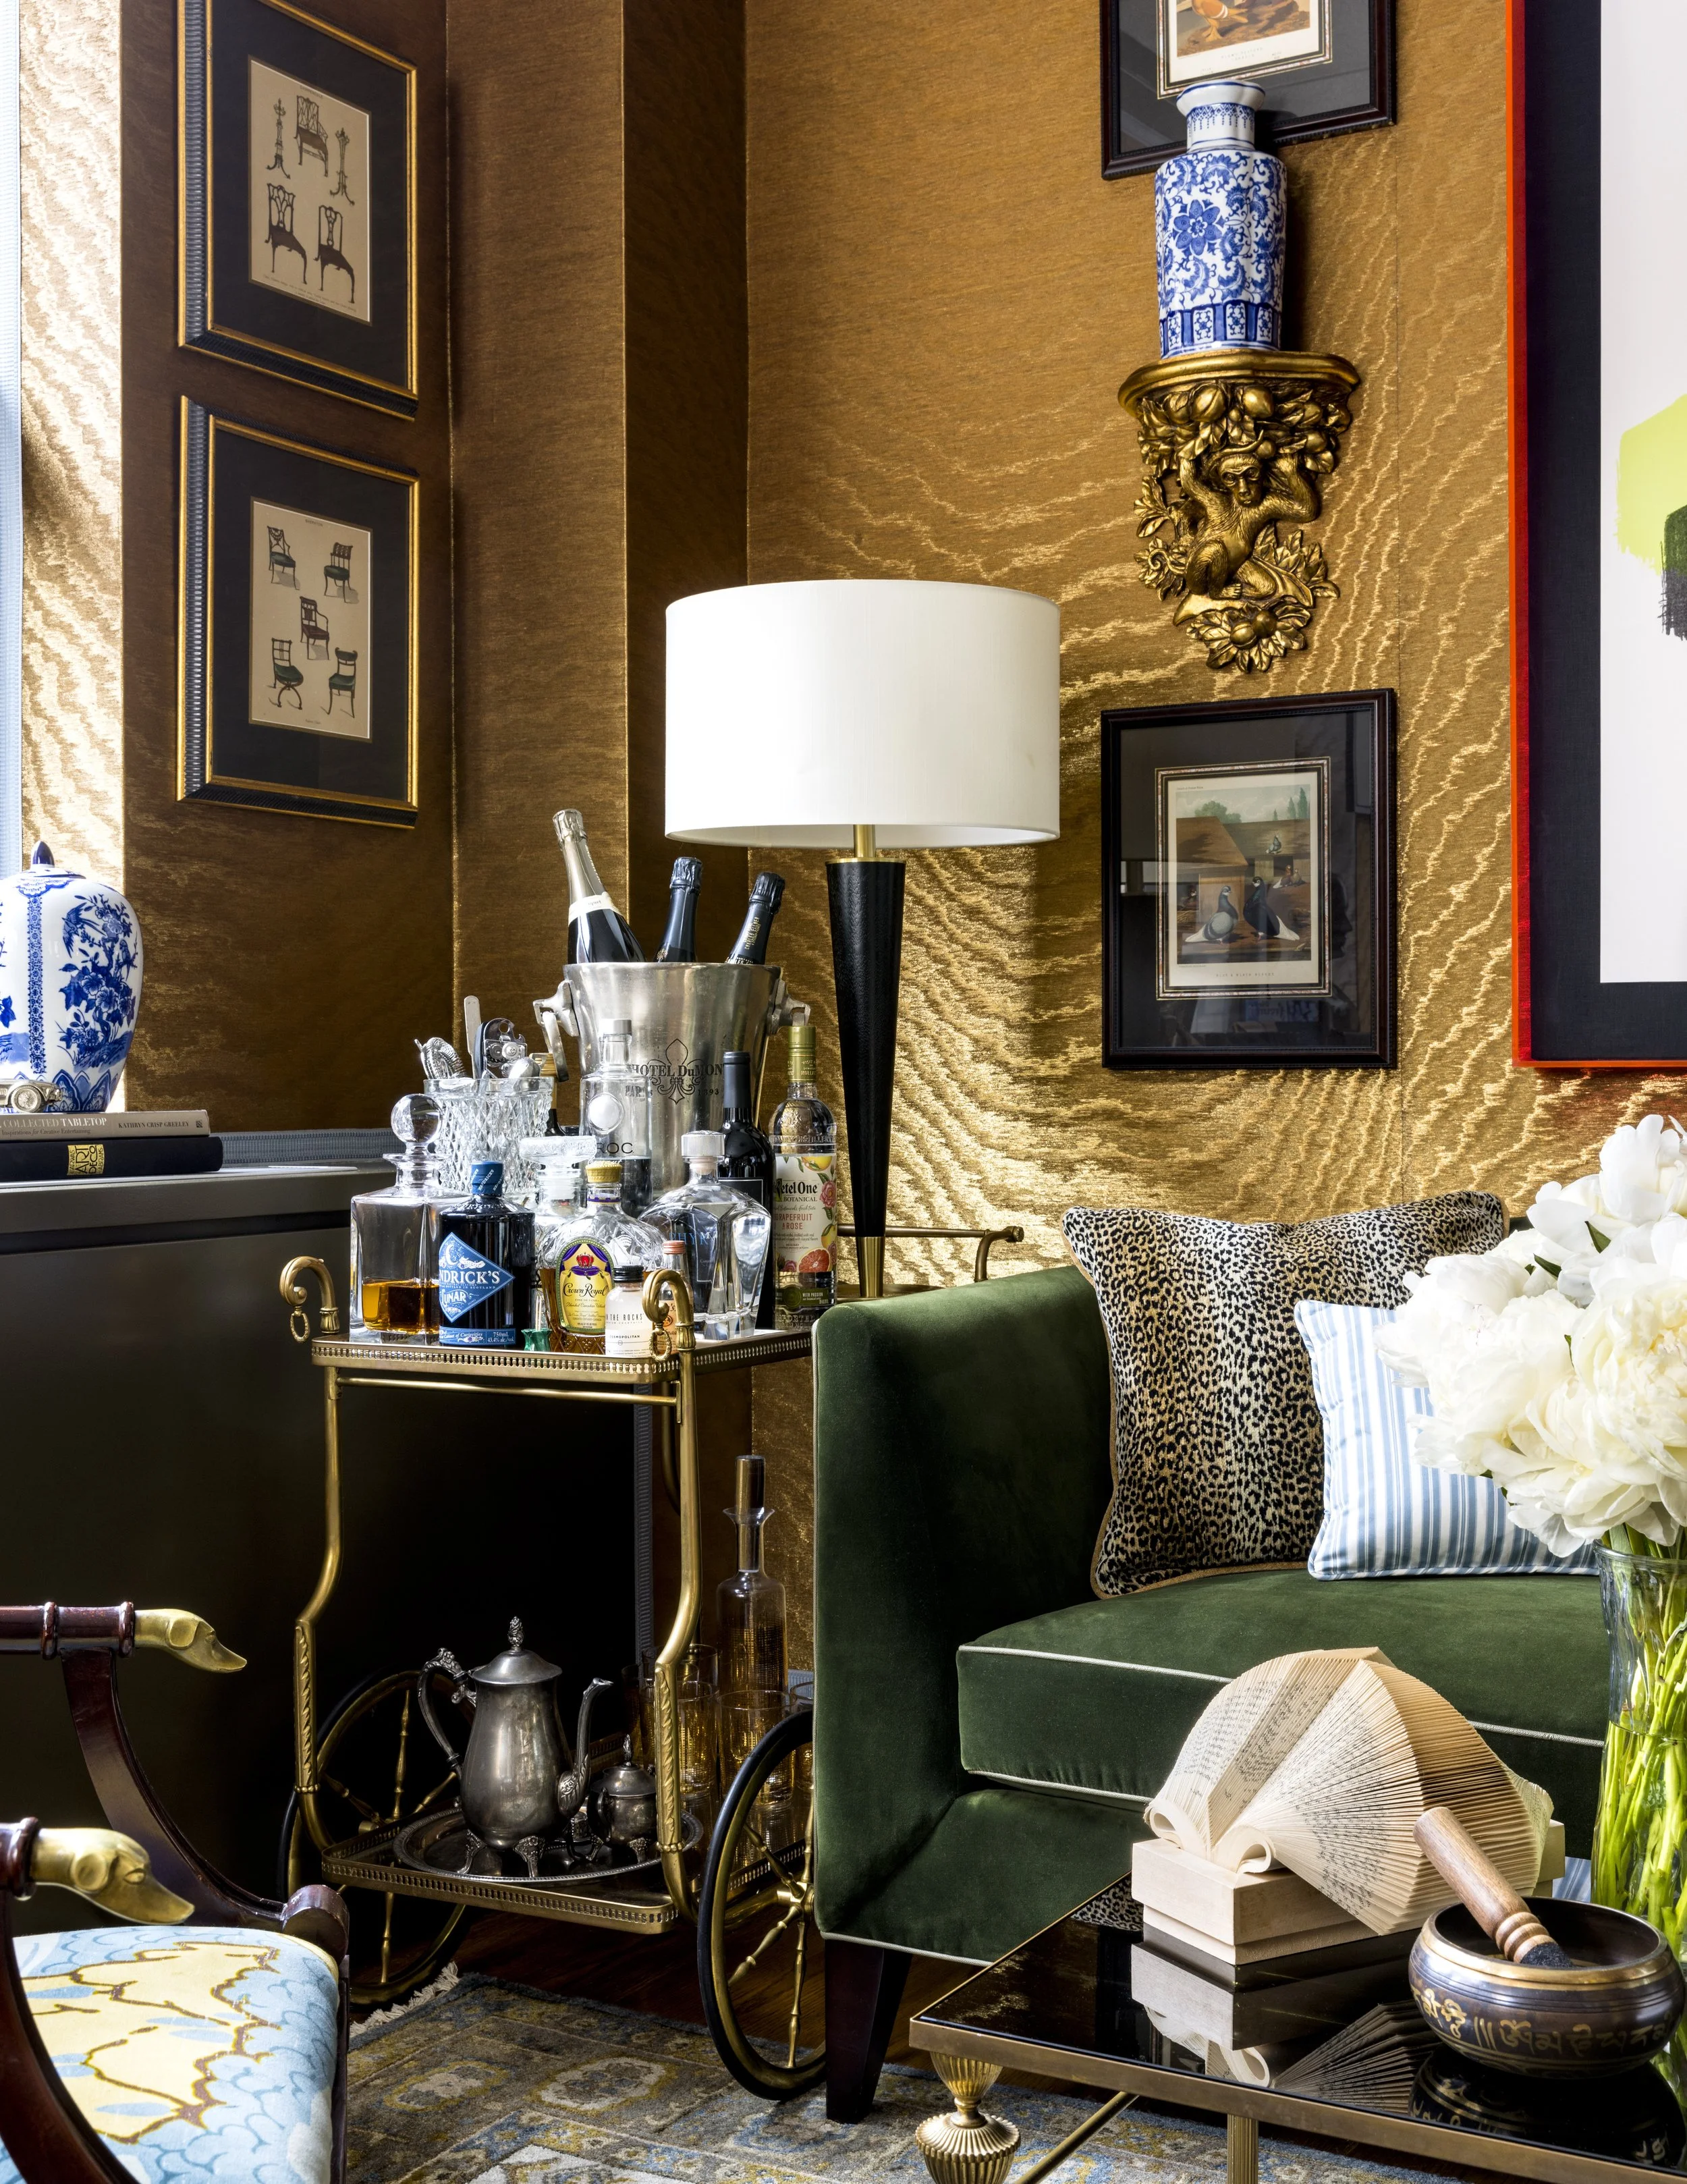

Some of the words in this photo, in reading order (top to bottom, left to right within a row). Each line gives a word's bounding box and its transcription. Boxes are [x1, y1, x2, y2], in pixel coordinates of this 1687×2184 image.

[632, 1064, 675, 1077] HOTEL
[677, 1065, 724, 1077] DuMON
[3, 1118, 59, 1128] COLLECTED
[60, 1117, 107, 1126] TABLETOP
[597, 1142, 634, 1154] ROC
[74, 1145, 90, 1174] ART
[88, 1145, 98, 1174] DECO
[798, 1182, 818, 1194] One
[439, 1270, 501, 1284] NDRICK'S
[563, 1282, 584, 1296] Crown
[579, 1283, 609, 1298] Royal
[441, 1288, 467, 1307] LUNAR
